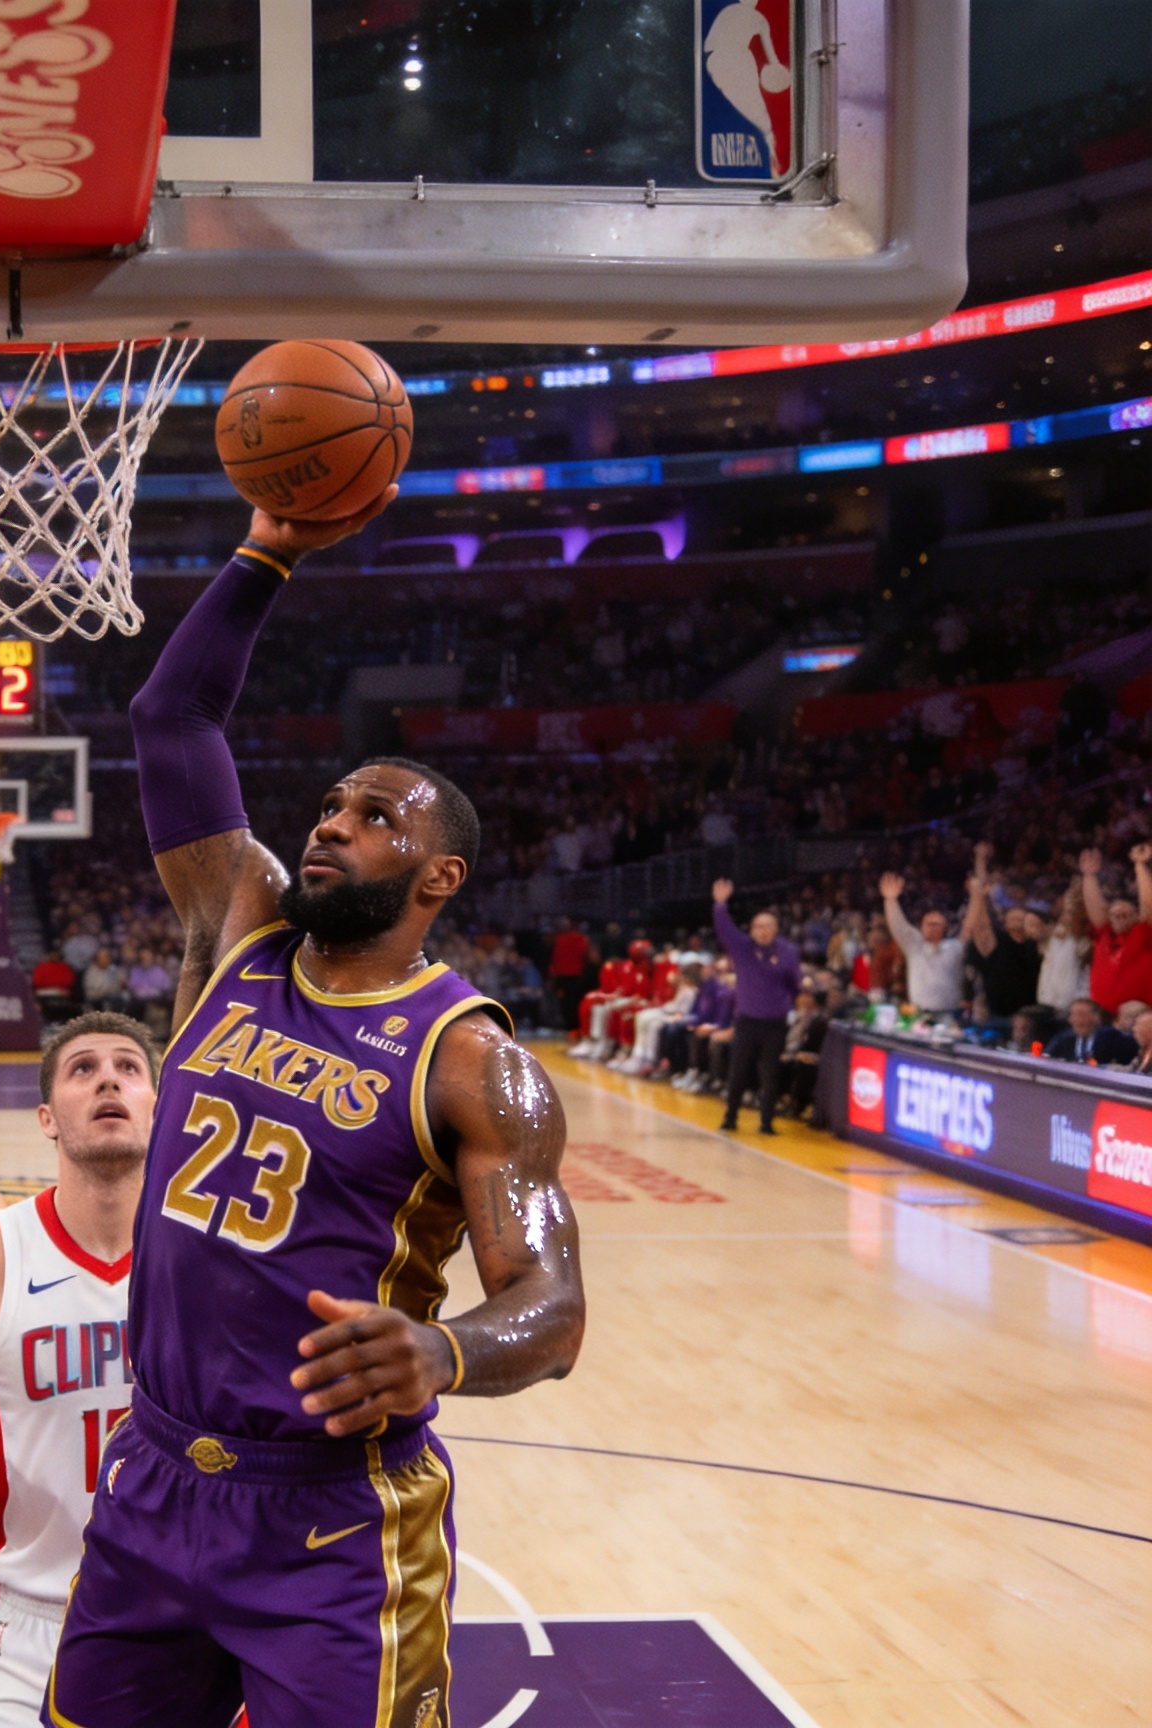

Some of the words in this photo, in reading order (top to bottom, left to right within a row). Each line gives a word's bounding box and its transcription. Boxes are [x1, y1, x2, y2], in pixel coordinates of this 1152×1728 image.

[178, 1001, 391, 1130] LAKERS
[161, 1092, 312, 1253] 23
[83, 1407, 132, 1493] 1
